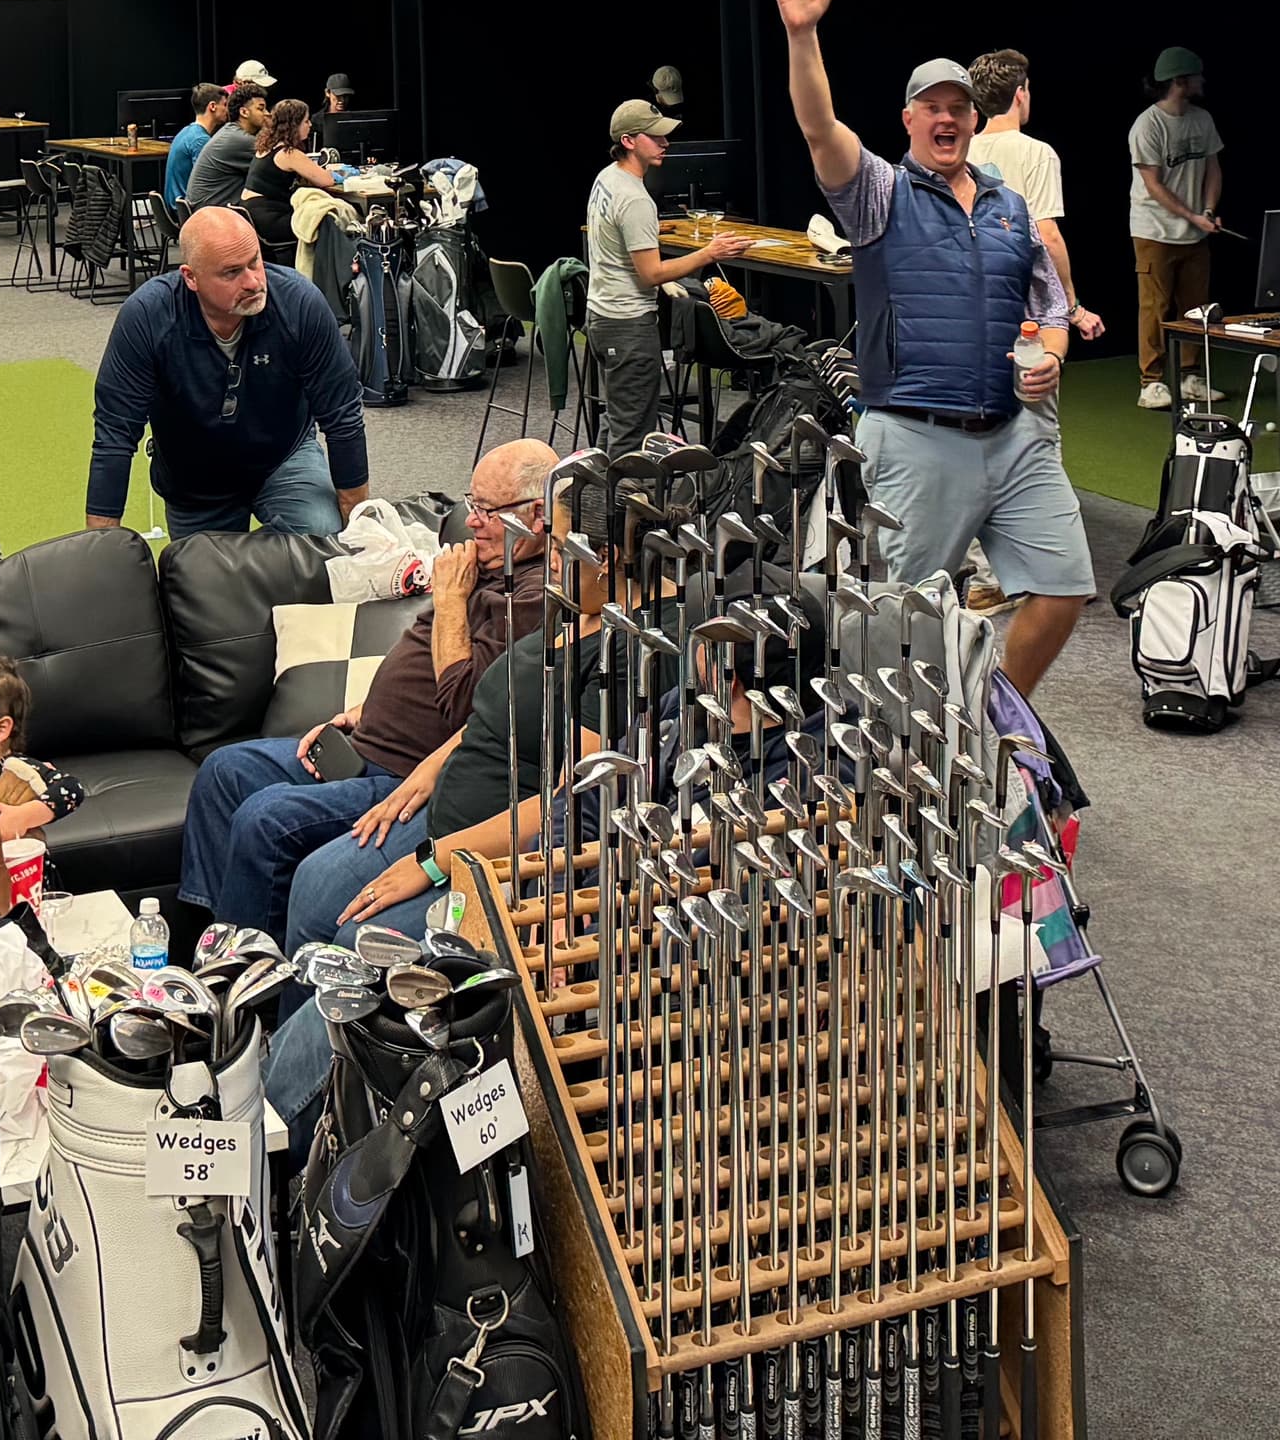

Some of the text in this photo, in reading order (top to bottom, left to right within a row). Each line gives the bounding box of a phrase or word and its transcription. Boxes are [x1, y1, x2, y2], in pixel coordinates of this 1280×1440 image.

[450, 1082, 506, 1125] Wedges
[156, 1132, 237, 1155] Wedges
[480, 1115, 498, 1145] 60°
[184, 1162, 215, 1181] 58°
[457, 1388, 558, 1435] JPX
